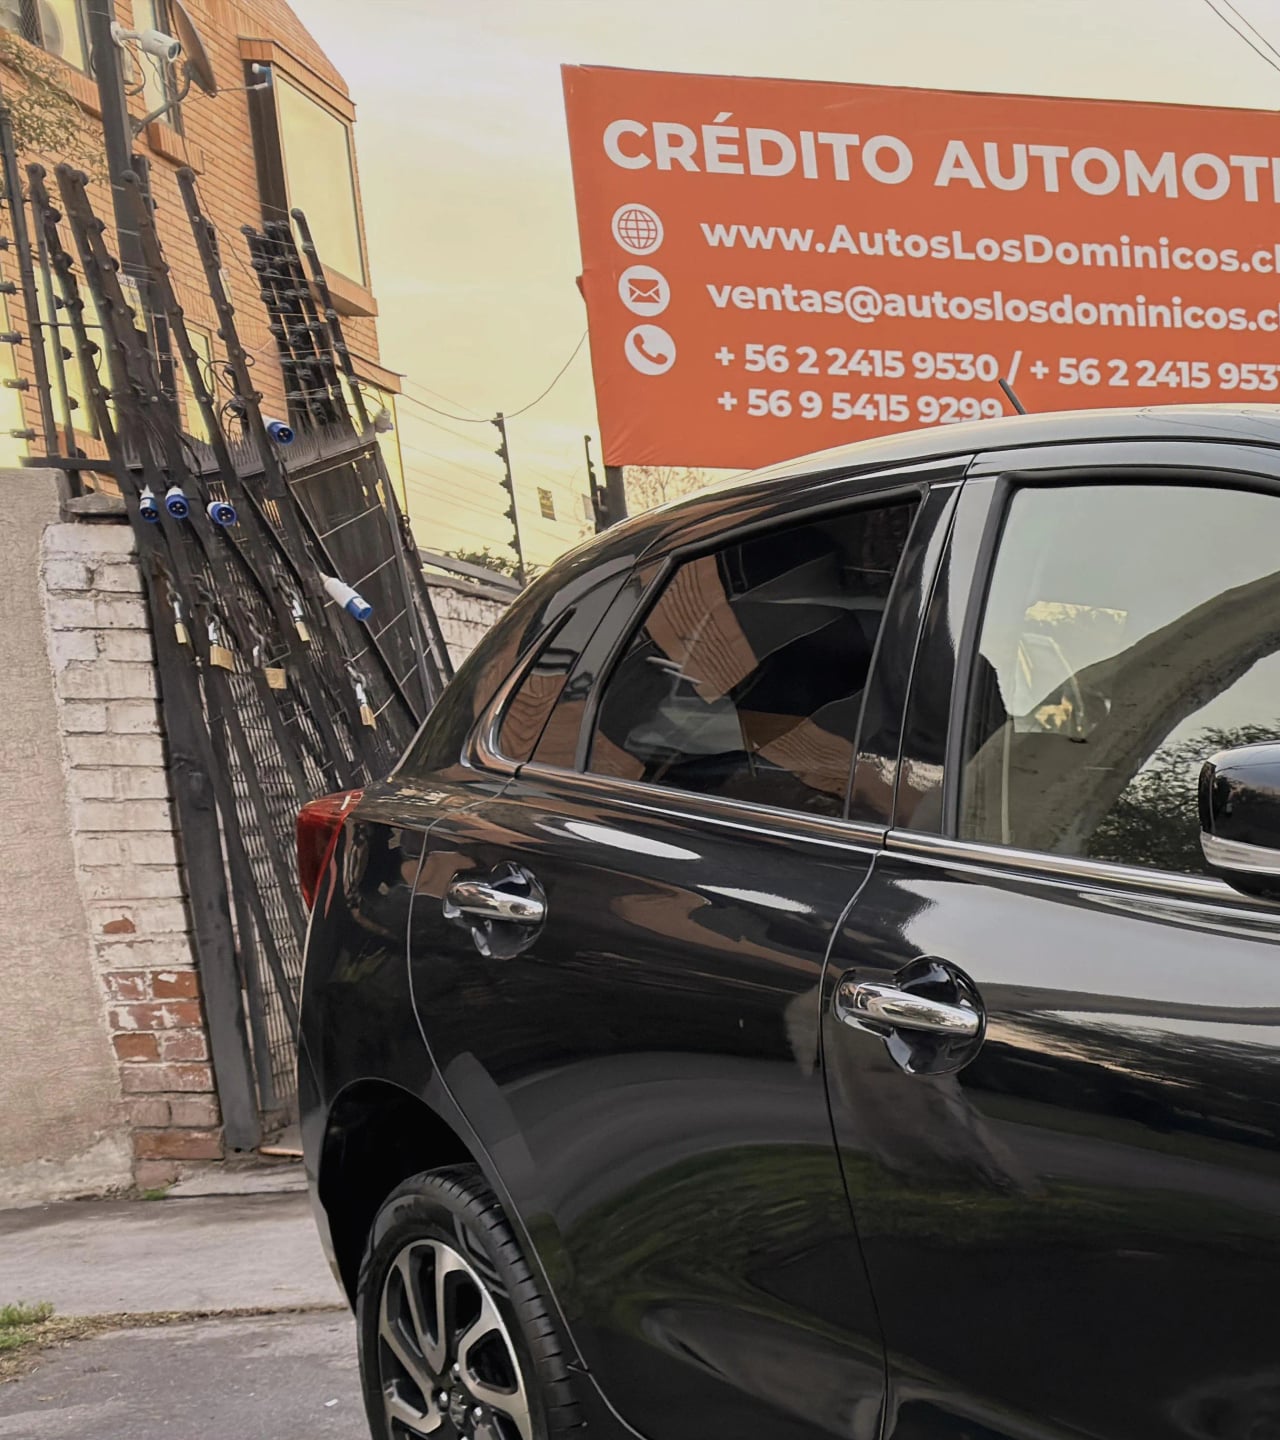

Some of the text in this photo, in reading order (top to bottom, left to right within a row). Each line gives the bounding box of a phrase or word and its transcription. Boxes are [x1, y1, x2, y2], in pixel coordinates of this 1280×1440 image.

[603, 111, 914, 185] CRÉDITO
[744, 343, 790, 373] 56
[795, 345, 820, 375] 2
[825, 347, 906, 379] 2415
[911, 351, 999, 382] 9530
[1058, 357, 1101, 386] 56
[1107, 358, 1130, 387] 2
[1135, 359, 1211, 389] 2415
[747, 388, 793, 418] 56
[798, 390, 823, 419] 9
[831, 392, 910, 422] 5415
[916, 395, 1004, 423] 9299
